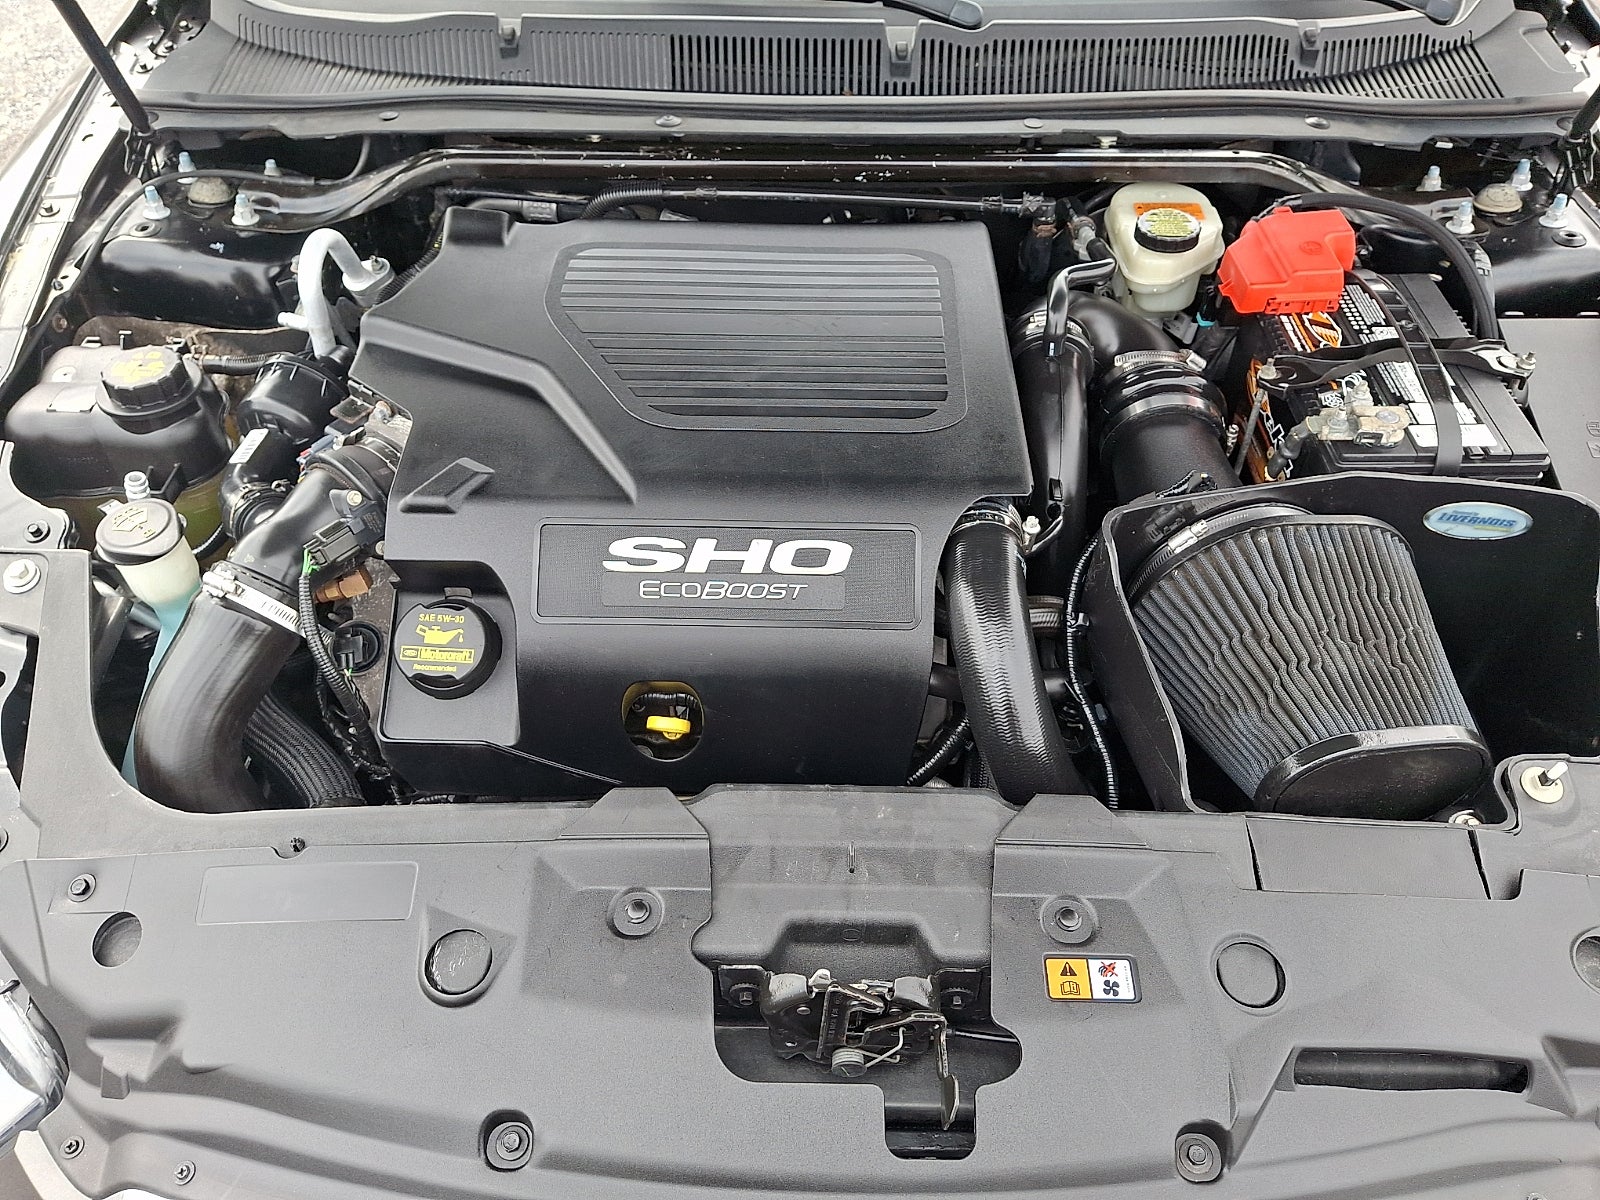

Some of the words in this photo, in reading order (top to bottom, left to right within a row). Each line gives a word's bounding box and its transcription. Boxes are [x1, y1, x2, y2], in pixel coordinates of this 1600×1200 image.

[1438, 512, 1516, 527] LIVERNOIS
[602, 536, 854, 575] SHO
[418, 613, 436, 622] SAE
[437, 614, 465, 624] 5W-30
